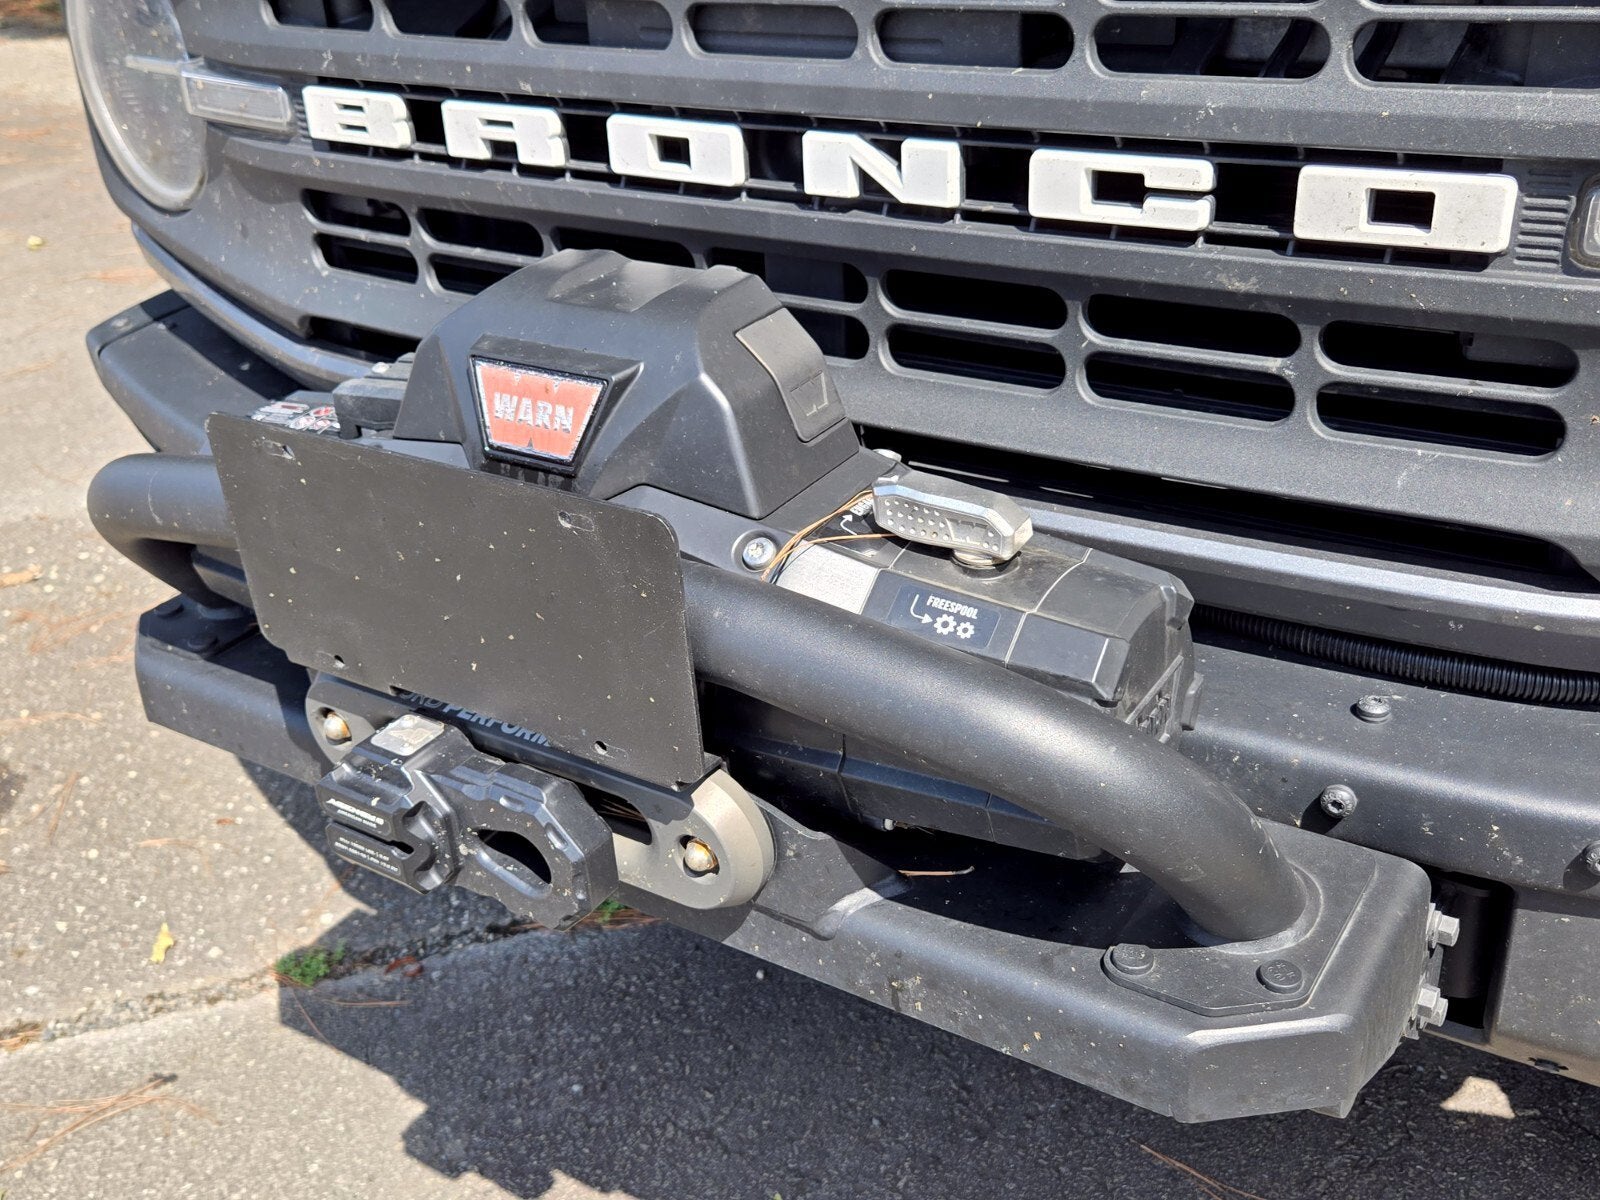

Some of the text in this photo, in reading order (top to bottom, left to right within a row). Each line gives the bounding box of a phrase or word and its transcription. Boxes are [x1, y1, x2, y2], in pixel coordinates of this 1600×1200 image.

[301, 85, 1519, 254] BRONCO
[493, 391, 574, 433] WARN
[926, 595, 979, 620] FREESPOOL
